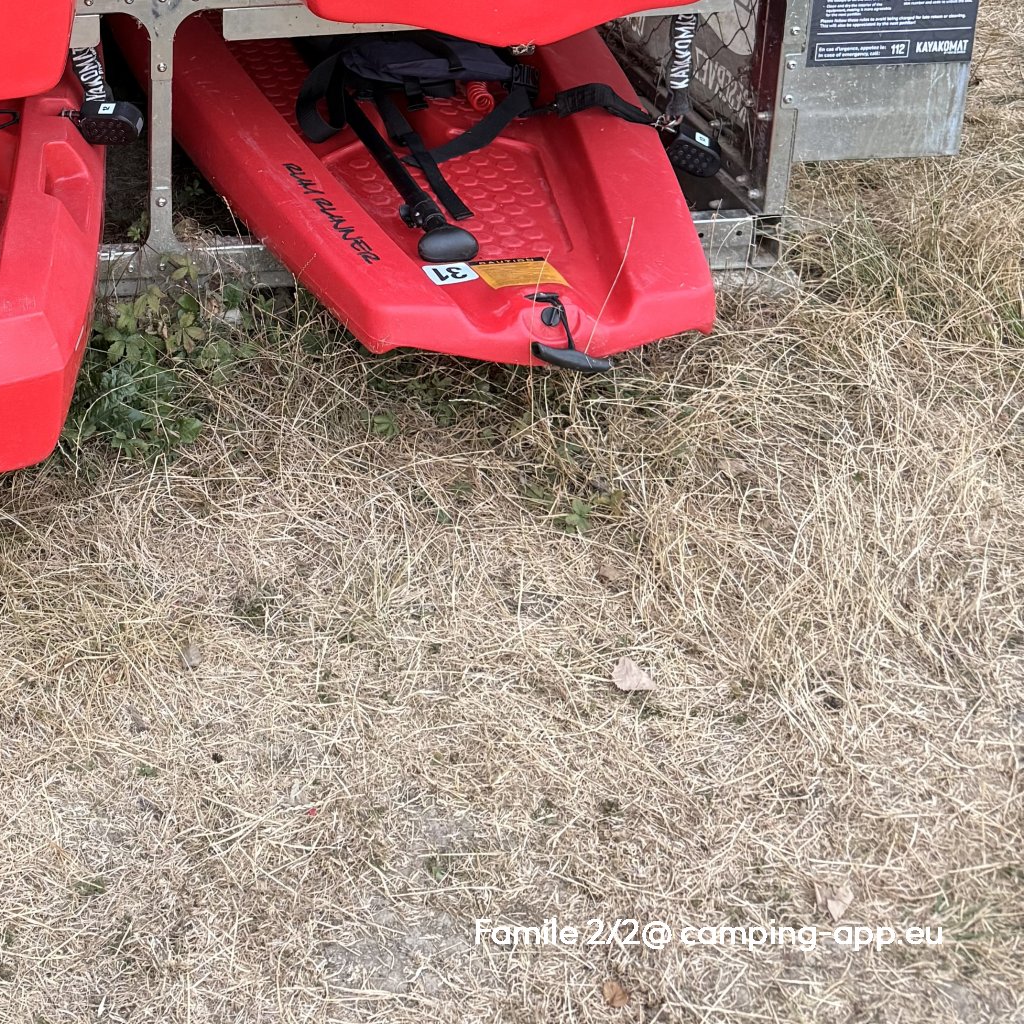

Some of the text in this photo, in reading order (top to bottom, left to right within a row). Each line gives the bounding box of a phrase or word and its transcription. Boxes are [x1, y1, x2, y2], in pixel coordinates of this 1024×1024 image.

[890, 43, 906, 55] 112
[915, 39, 969, 53] KAYAKOMAT
[311, 197, 381, 265] RUNNER
[431, 266, 468, 282] 31
